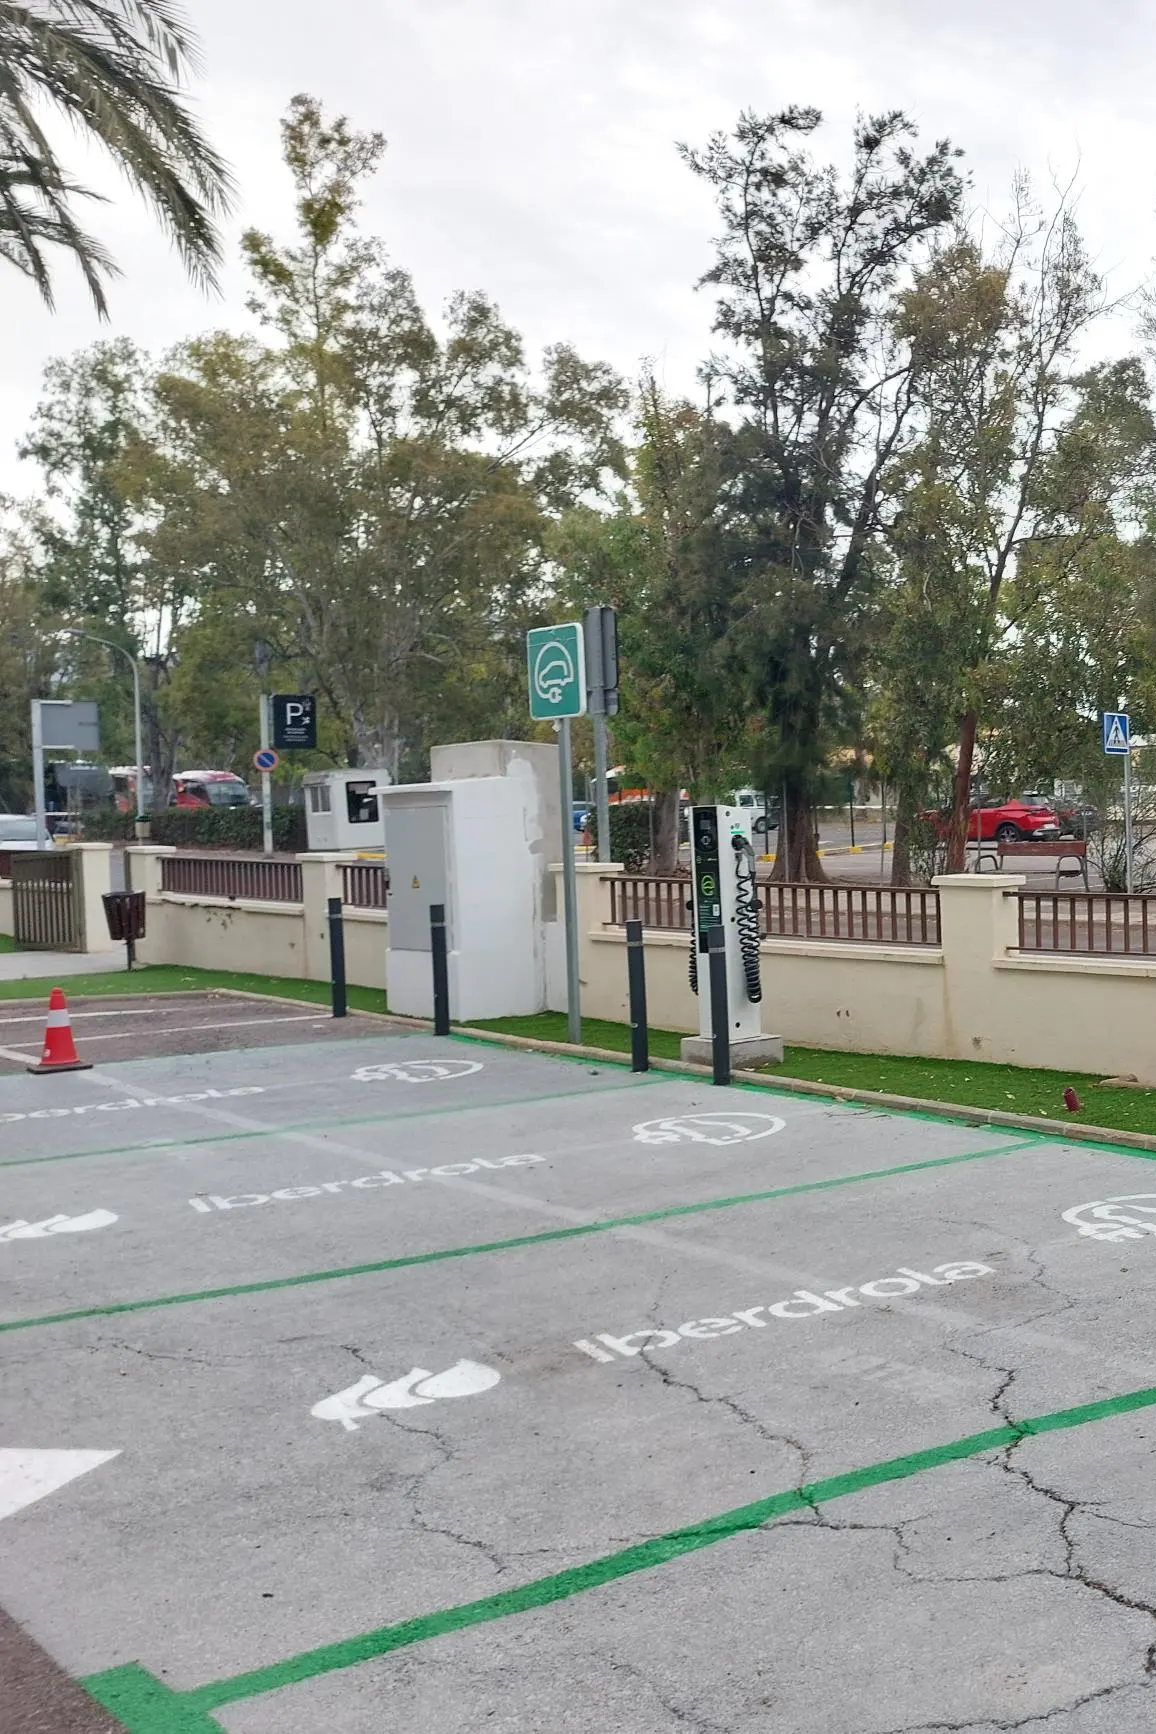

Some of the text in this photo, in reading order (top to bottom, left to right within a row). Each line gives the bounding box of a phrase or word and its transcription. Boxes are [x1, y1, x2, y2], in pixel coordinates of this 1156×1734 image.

[286, 702, 304, 725] P
[0, 1086, 266, 1123] erdrola
[188, 1153, 547, 1213] Iberdrola
[572, 1260, 999, 1365] Iberdrola
